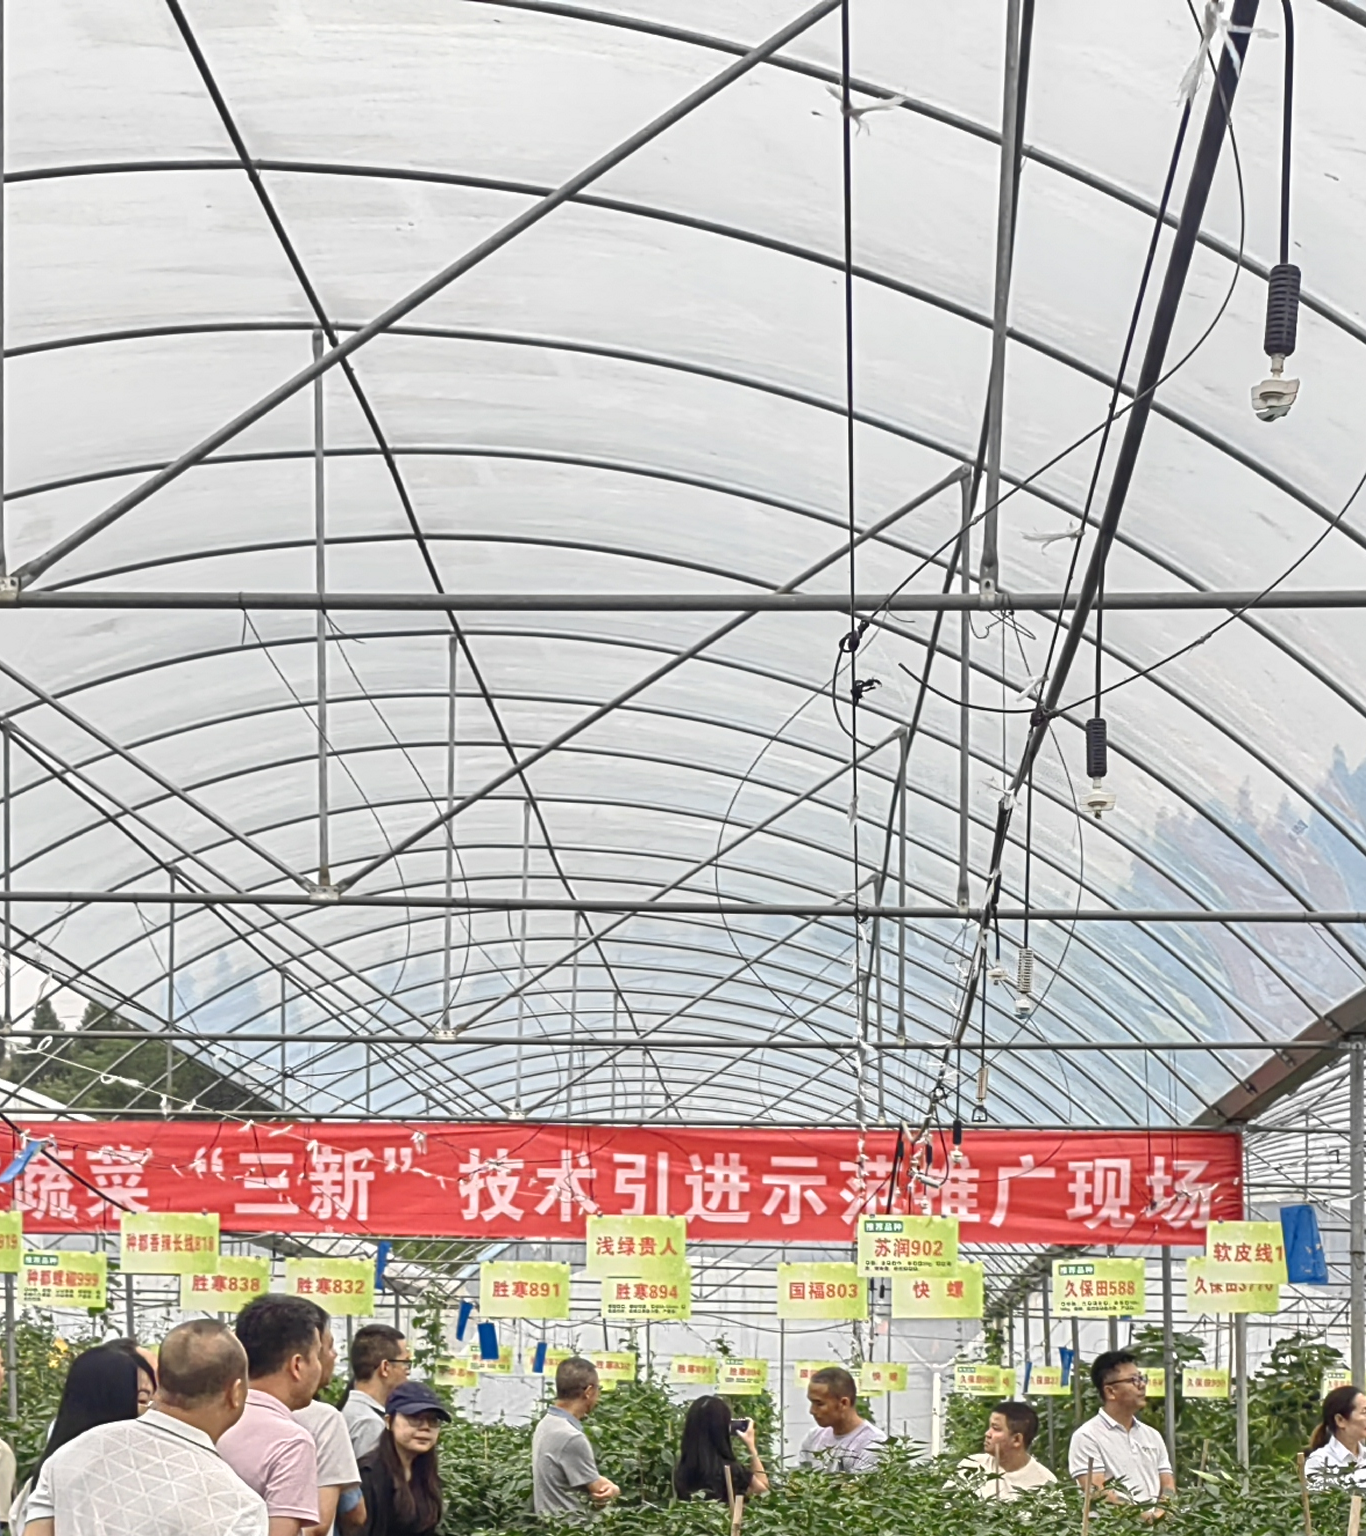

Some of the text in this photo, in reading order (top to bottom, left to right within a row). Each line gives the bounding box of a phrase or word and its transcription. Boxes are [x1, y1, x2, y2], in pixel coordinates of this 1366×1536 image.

[865, 1222, 903, 1232] 推荐品种
[596, 1236, 676, 1257] 浅绿贵人
[874, 1238, 944, 1258] 苏润902
[1058, 1264, 1094, 1275] 推荐品种
[191, 1274, 261, 1293] 胜寒838
[296, 1277, 366, 1296] 胜寒832
[492, 1281, 561, 1299] 胜寒891
[615, 1283, 679, 1302] 胜寒894
[788, 1282, 859, 1301] 国福803
[1064, 1279, 1137, 1299] 久保田588
